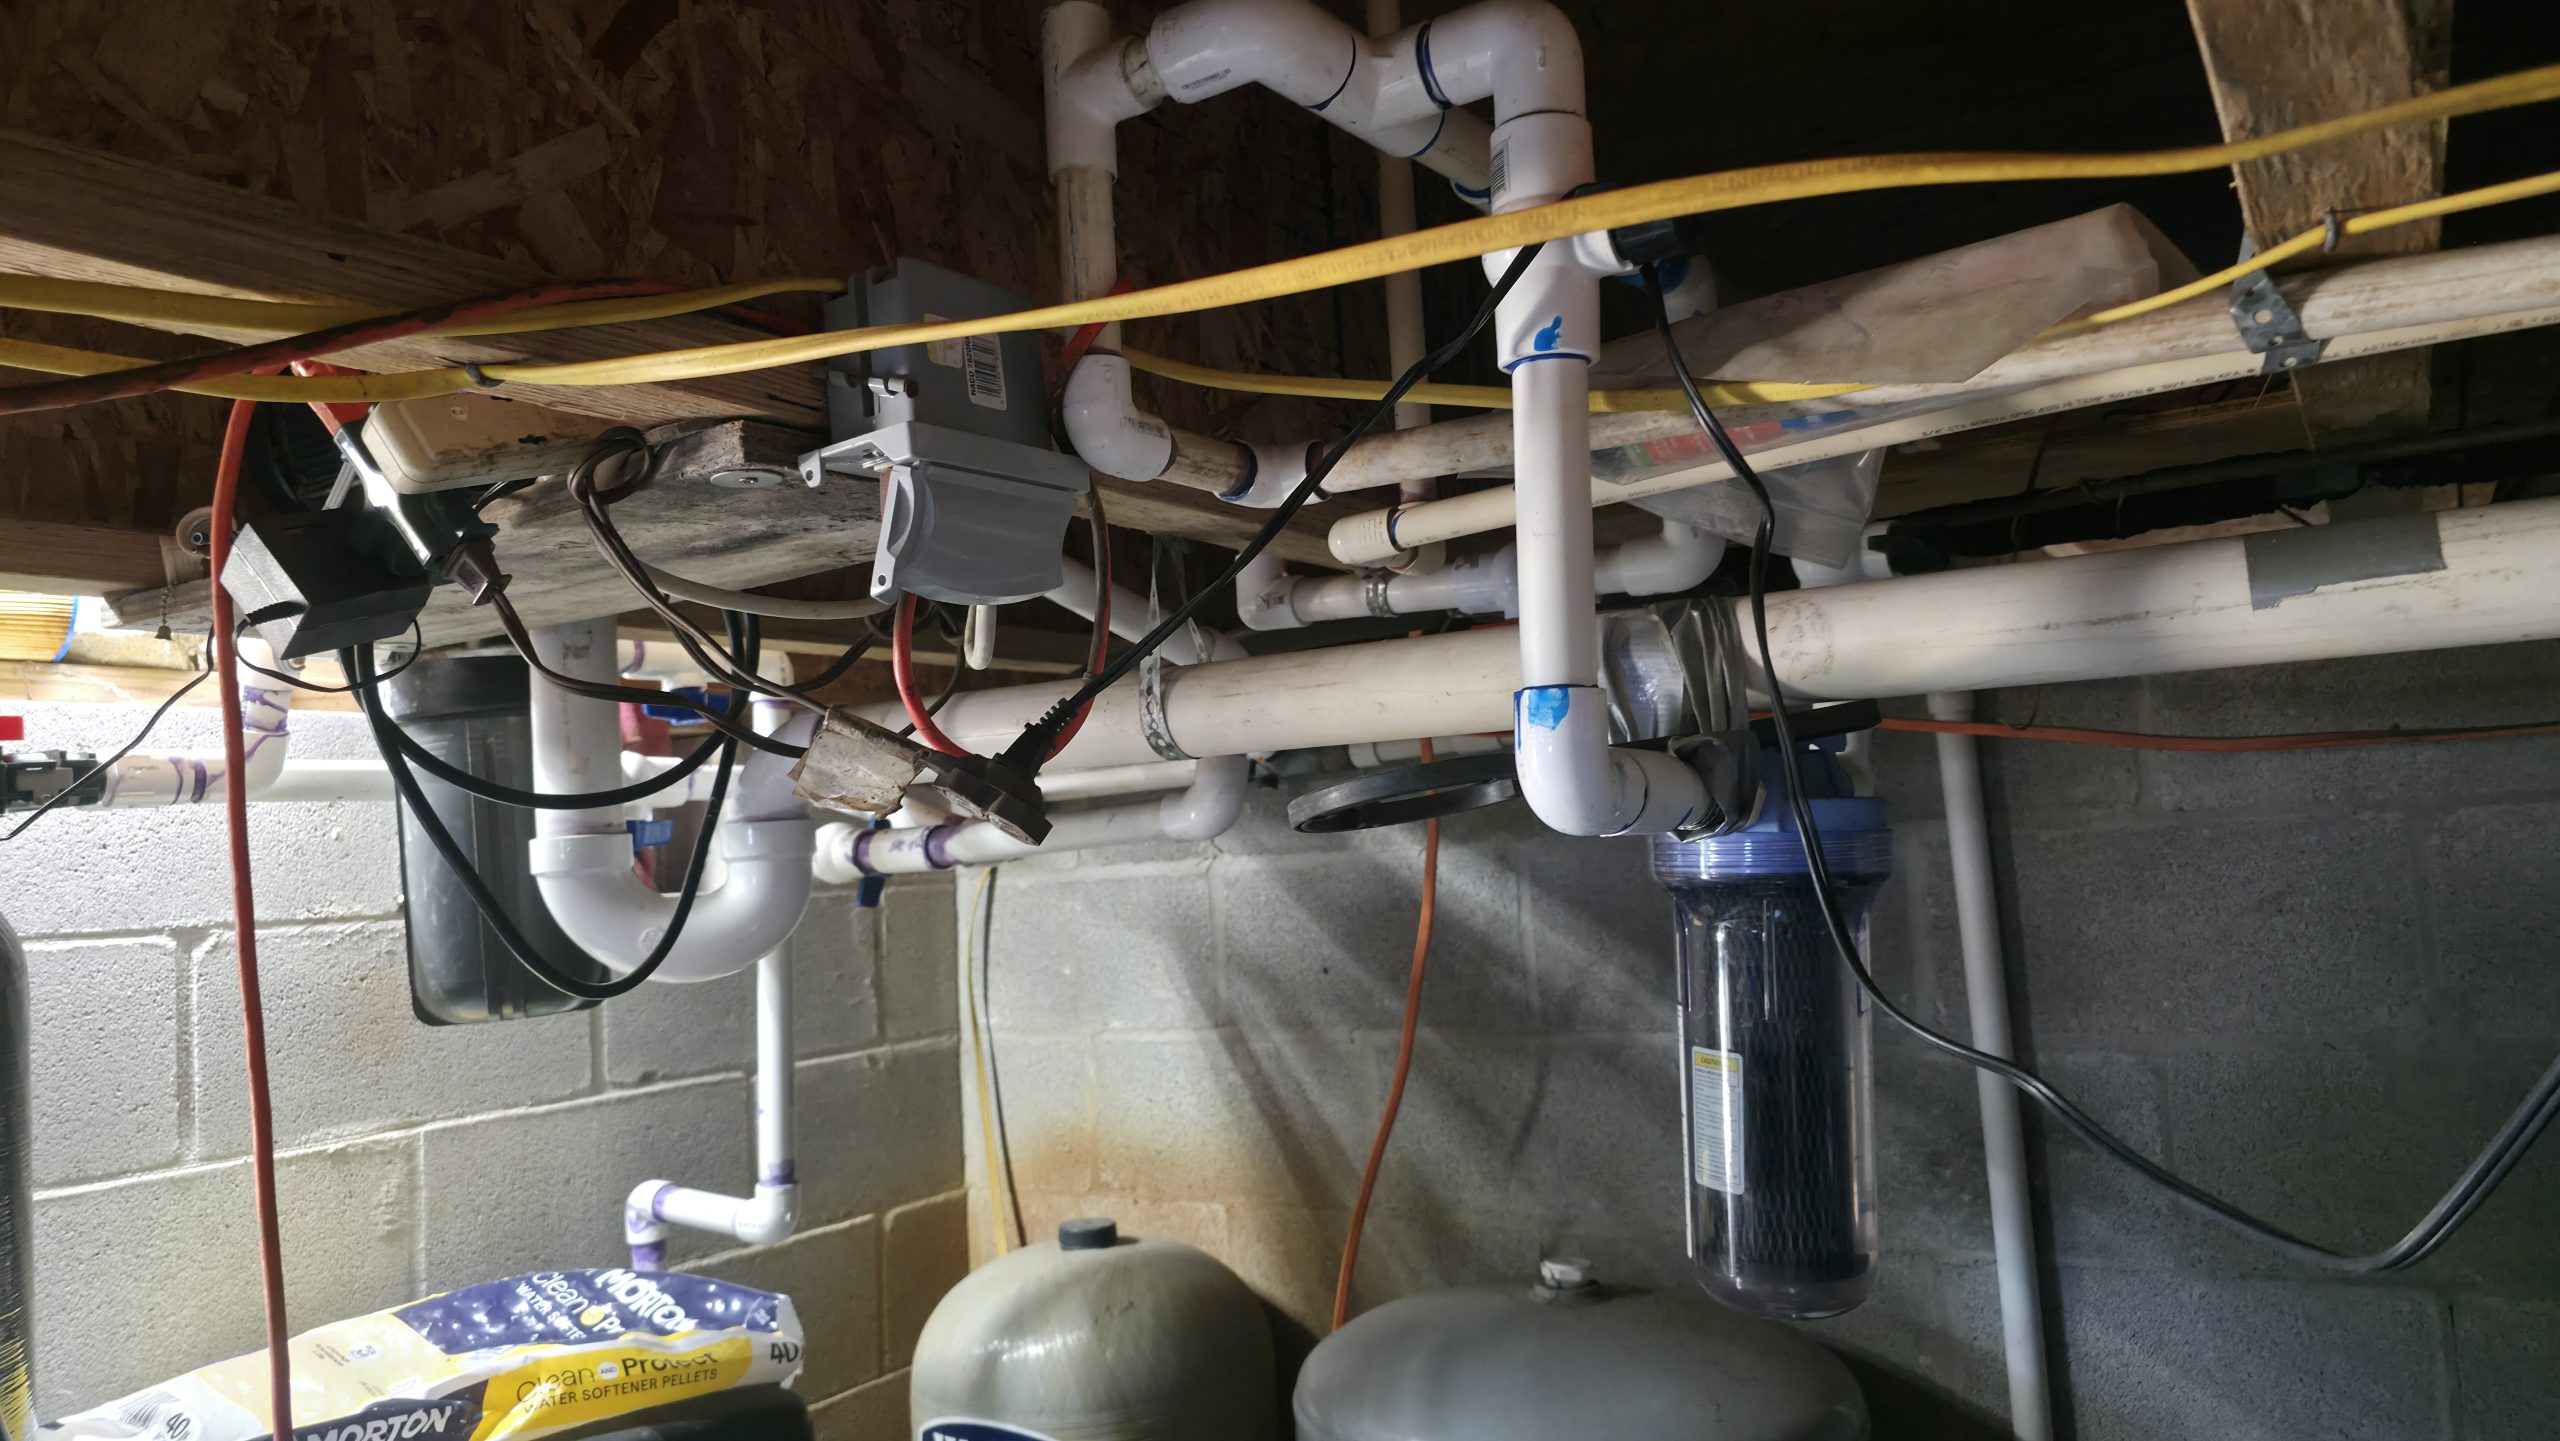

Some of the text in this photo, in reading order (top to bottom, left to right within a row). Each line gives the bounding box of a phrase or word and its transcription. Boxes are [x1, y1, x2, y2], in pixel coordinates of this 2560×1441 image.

[532, 1272, 589, 1314] Clean
[771, 1341, 800, 1364] 40
[517, 1367, 596, 1403] Clean
[524, 1368, 718, 1413] WATER SOFTENER PELLETS
